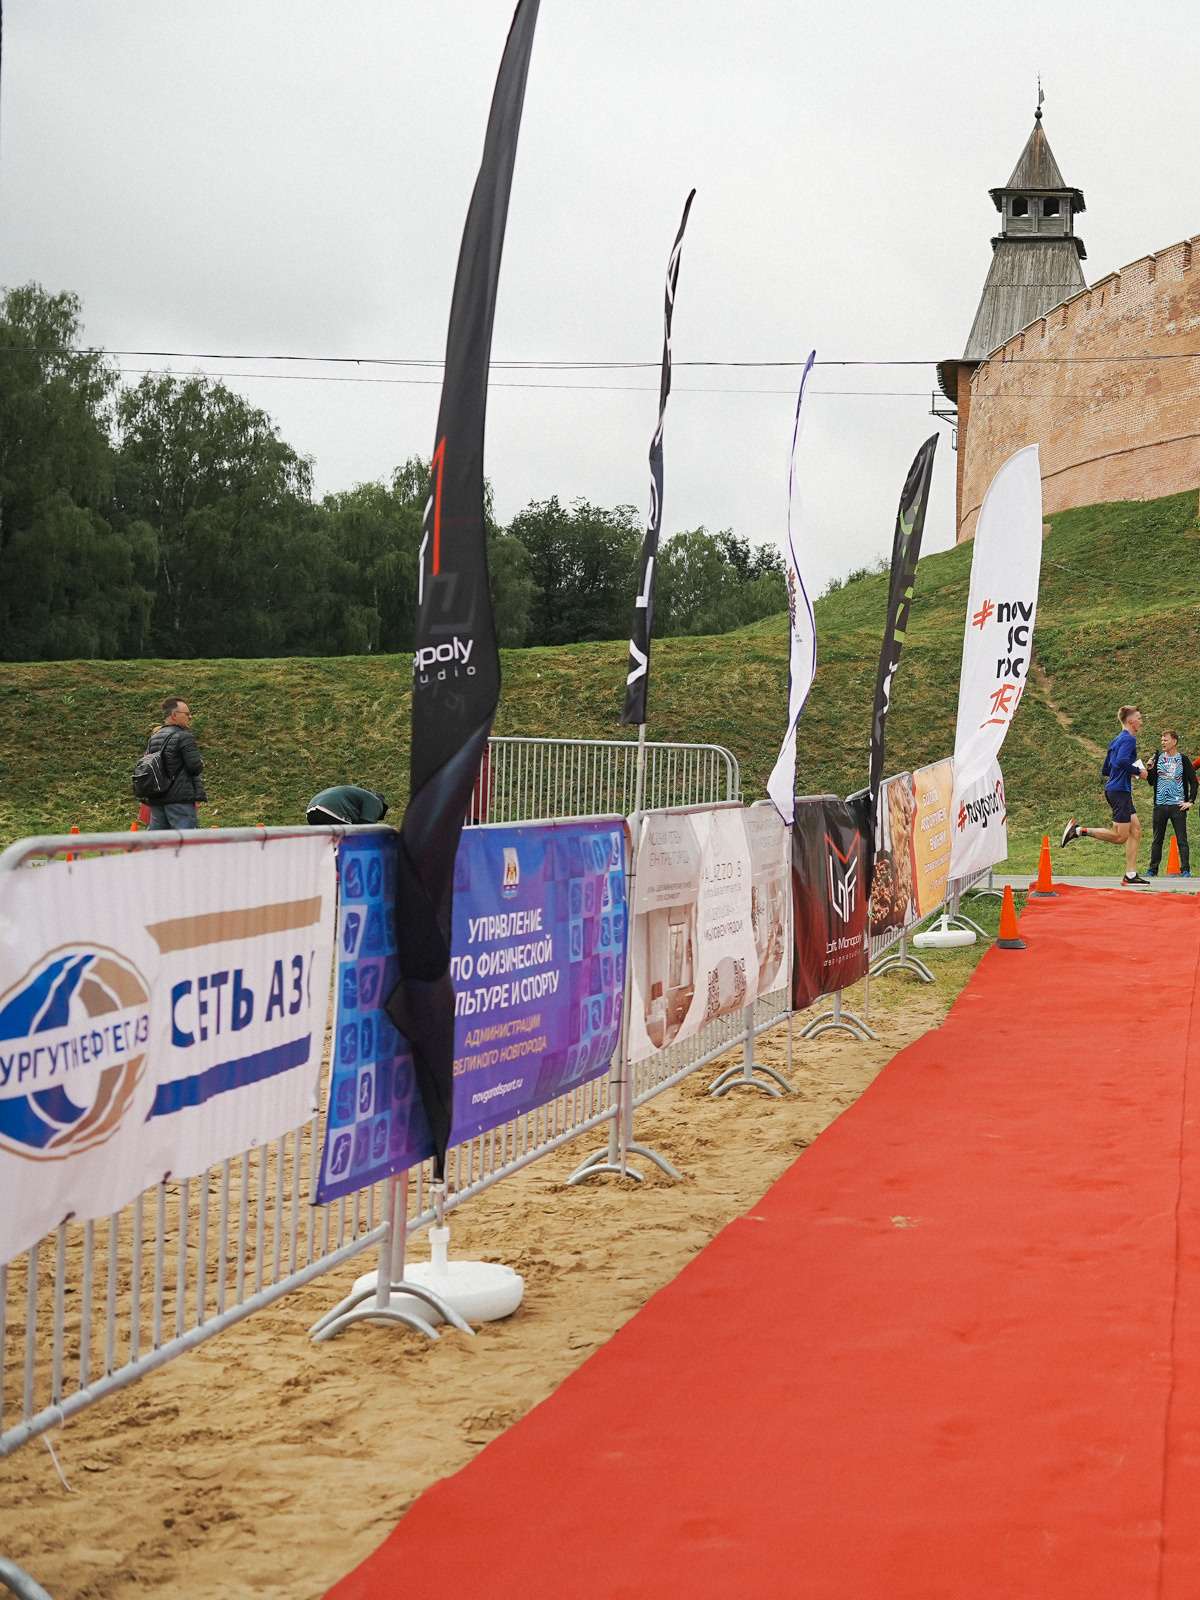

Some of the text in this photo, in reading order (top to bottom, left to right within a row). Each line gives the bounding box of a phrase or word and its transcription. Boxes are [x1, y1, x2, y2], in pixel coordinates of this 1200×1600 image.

[420, 666, 476, 684] udio
[468, 908, 543, 943] УПРАВЛЕНИЕ
[476, 934, 553, 978] ФИЗИЧЕСКОЙ
[170, 950, 315, 1048] СЕТЬ АЗ
[454, 969, 560, 1018] ЛЬТУРЕ И СПОРТУ
[0, 1014, 149, 1086] УРГУТНЕФТЕГАЗ
[465, 1014, 541, 1048] АДМИНИСТРАЦИИ
[453, 1036, 548, 1077] ВЕЛИКОГО НОВГОРОДА
[472, 1078, 524, 1105] novgorodsport.ru
